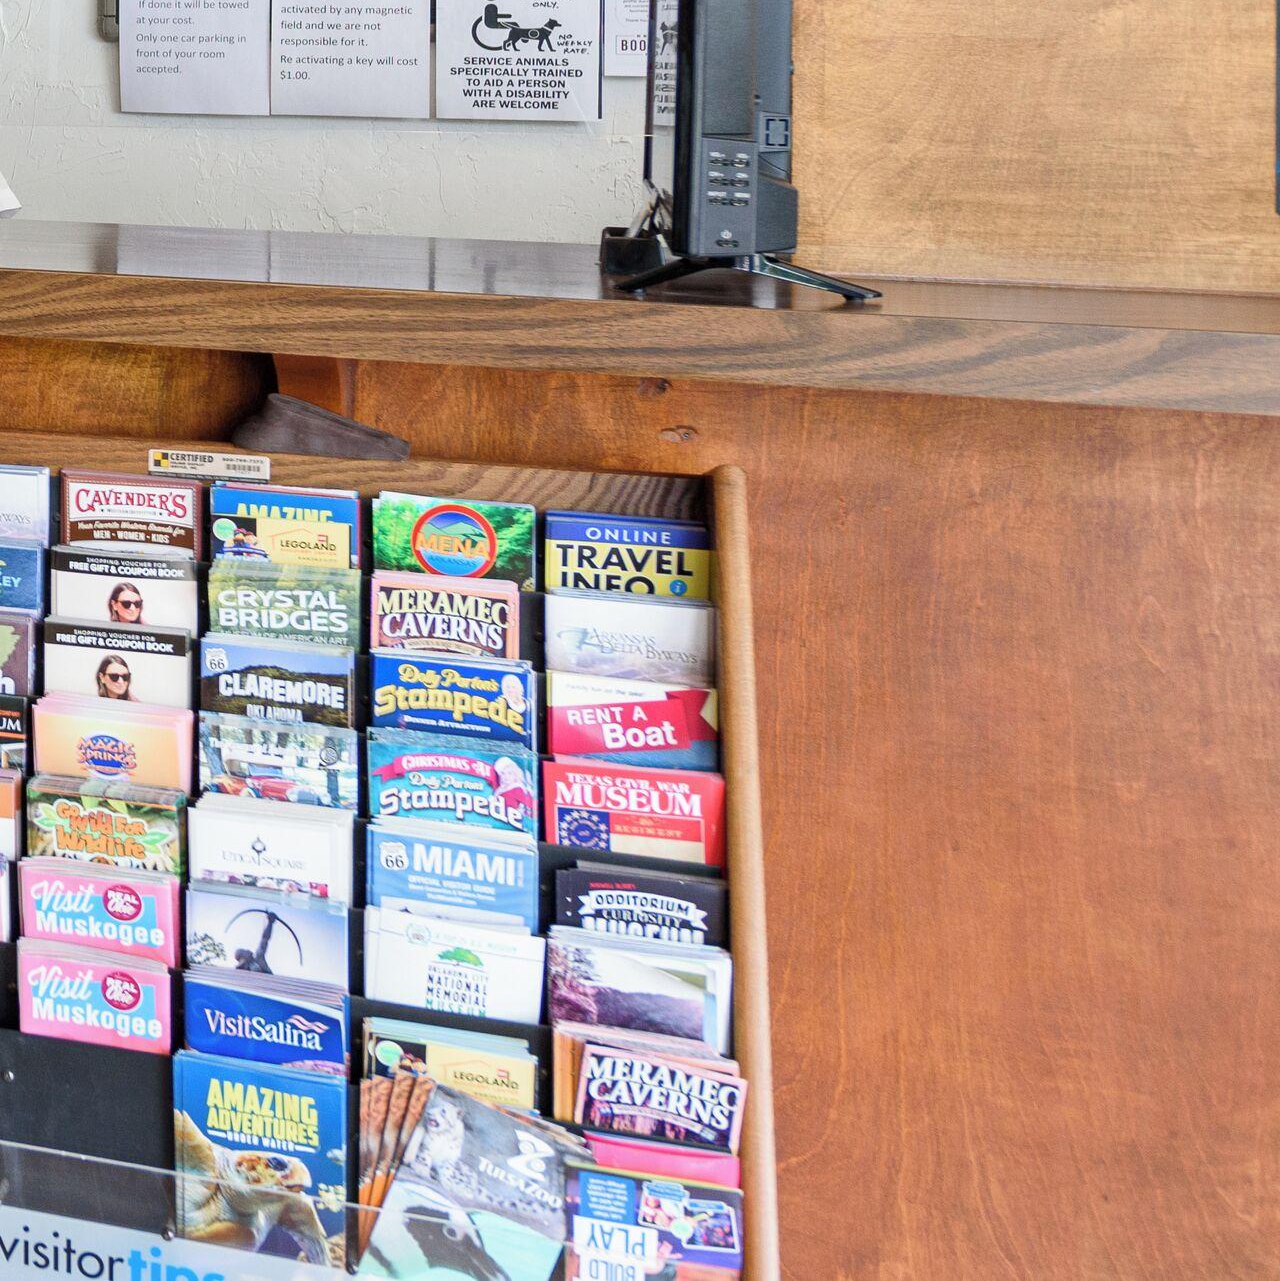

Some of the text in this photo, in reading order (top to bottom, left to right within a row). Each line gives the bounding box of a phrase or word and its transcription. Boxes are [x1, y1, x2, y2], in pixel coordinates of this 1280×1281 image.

[450, 68, 583, 78] SPECIFICALLY TRAINED
[464, 57, 569, 67] SERVICE ANIMALS
[462, 89, 570, 98] WITH A DISABILITY
[466, 78, 566, 88] TO AID A PERSON
[472, 99, 559, 109] ARE WELCOME
[74, 490, 188, 519] CAVENDER'S
[586, 527, 671, 545] ONLINE
[556, 543, 693, 576] TRAVEL
[378, 586, 511, 628] MERAMEC
[382, 612, 504, 650] CAVERNS
[219, 672, 344, 710] CLAREMORE
[566, 703, 648, 726] RENT A
[603, 722, 677, 750] Boat
[556, 782, 703, 818] MUSEUM
[413, 843, 524, 886] MIAMI!
[31, 881, 93, 913] Visit
[35, 911, 164, 946] Muskogee
[204, 1008, 322, 1052] VisitSalina
[206, 1078, 318, 1120] AMAZING
[206, 1109, 318, 1148] ADVENTURES
